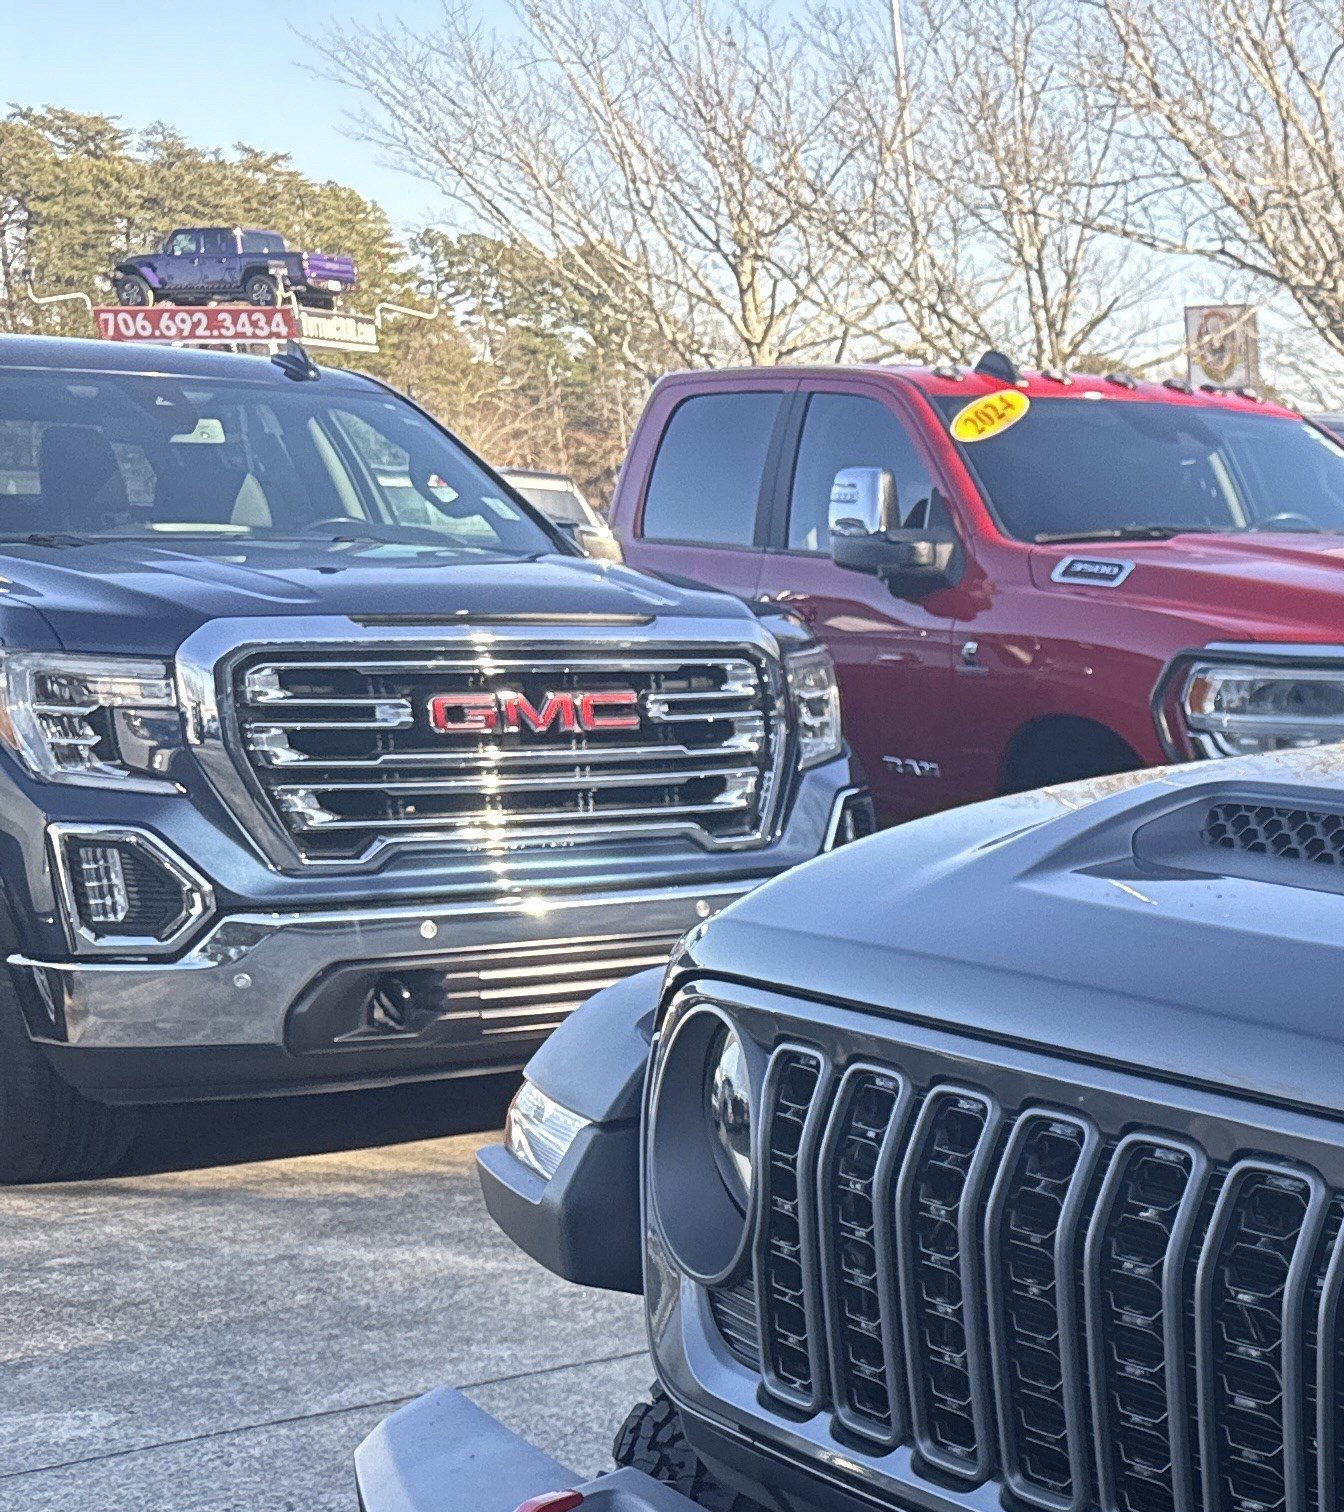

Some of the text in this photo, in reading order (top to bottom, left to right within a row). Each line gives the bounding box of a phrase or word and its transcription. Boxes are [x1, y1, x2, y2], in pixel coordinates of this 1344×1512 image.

[101, 311, 288, 337] 706.692.3434
[963, 395, 1015, 434] 2024
[427, 691, 641, 733] GMC
[881, 755, 940, 778] RAM
